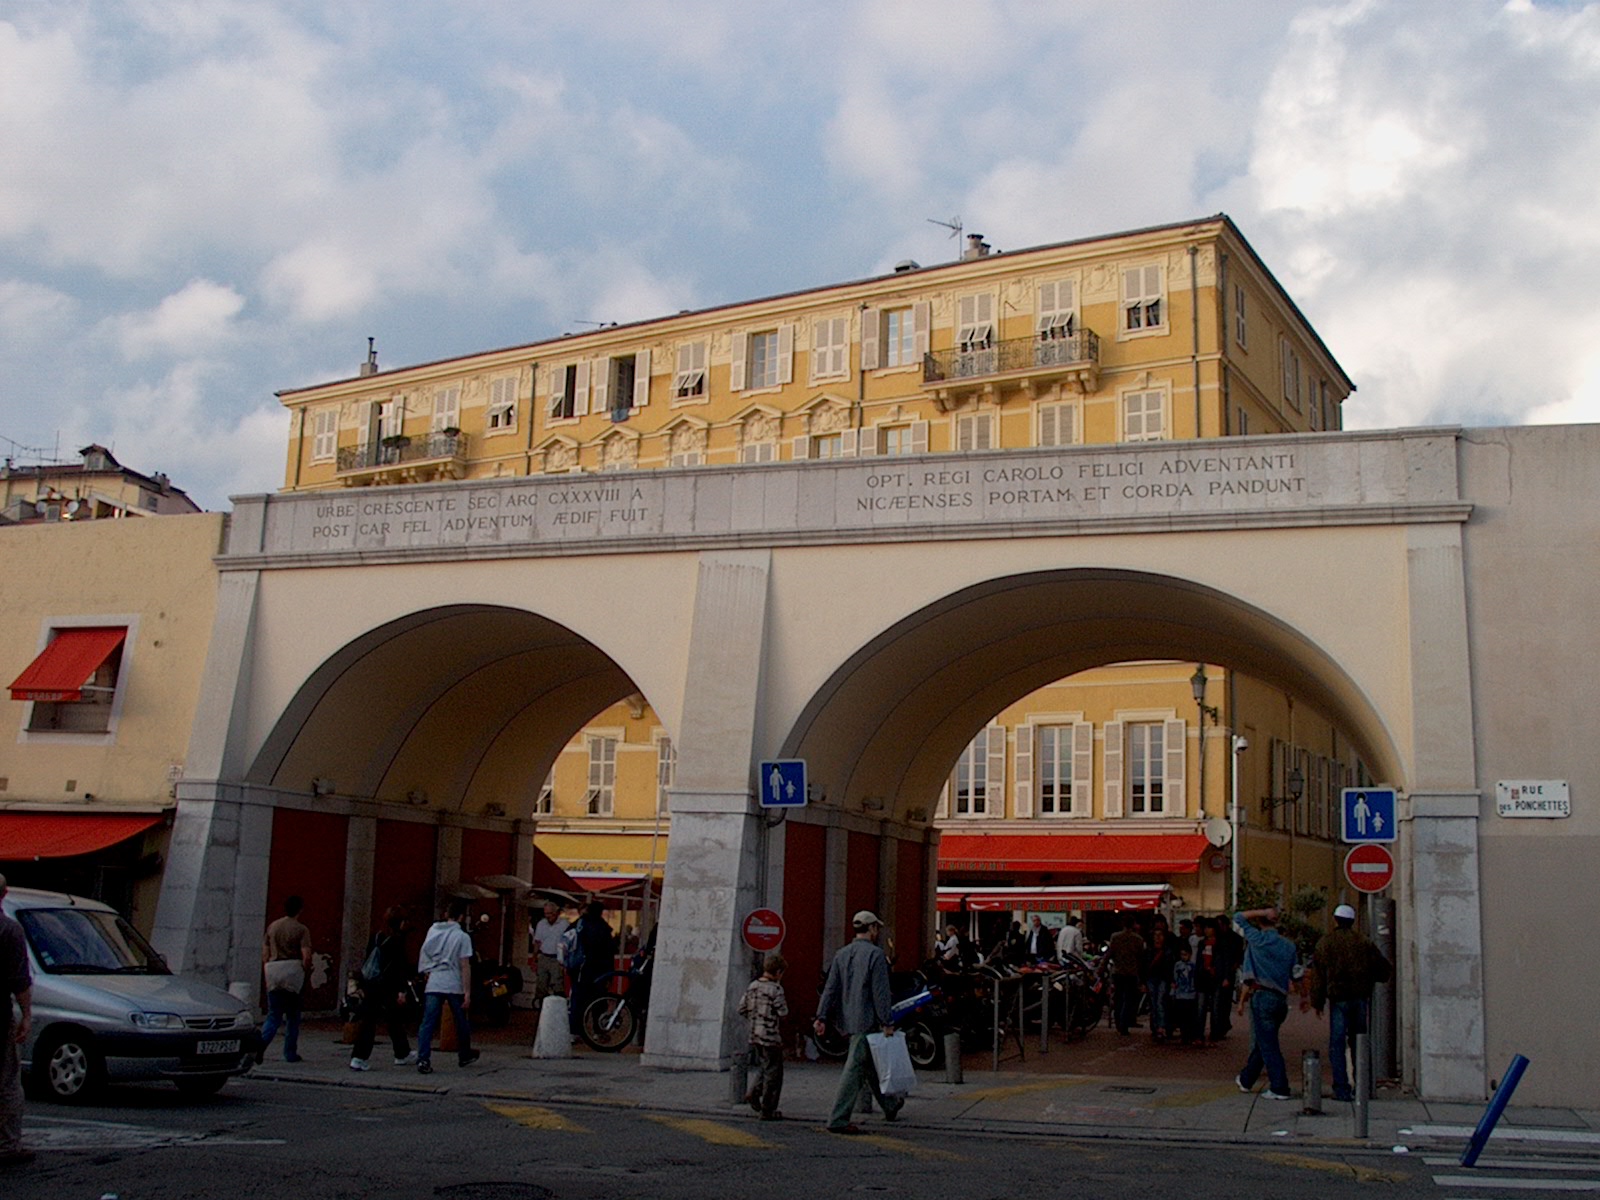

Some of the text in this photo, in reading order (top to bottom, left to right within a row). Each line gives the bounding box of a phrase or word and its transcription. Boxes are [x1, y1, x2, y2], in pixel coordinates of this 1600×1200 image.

[866, 454, 1295, 489] OPT. REGI CAROLO FELICI ADVENTANTI
[316, 487, 644, 518] URBE CRESCENTE SEC ARC CXXXVIII A
[857, 478, 1305, 511] NICÆENSES PORTAM ET CORDA PANDUNT
[312, 507, 648, 538] POST CAR FEL ADVENTUM ÆDIF FUIT
[1515, 800, 1568, 811] PONCHETTES
[1521, 785, 1543, 795] RUE
